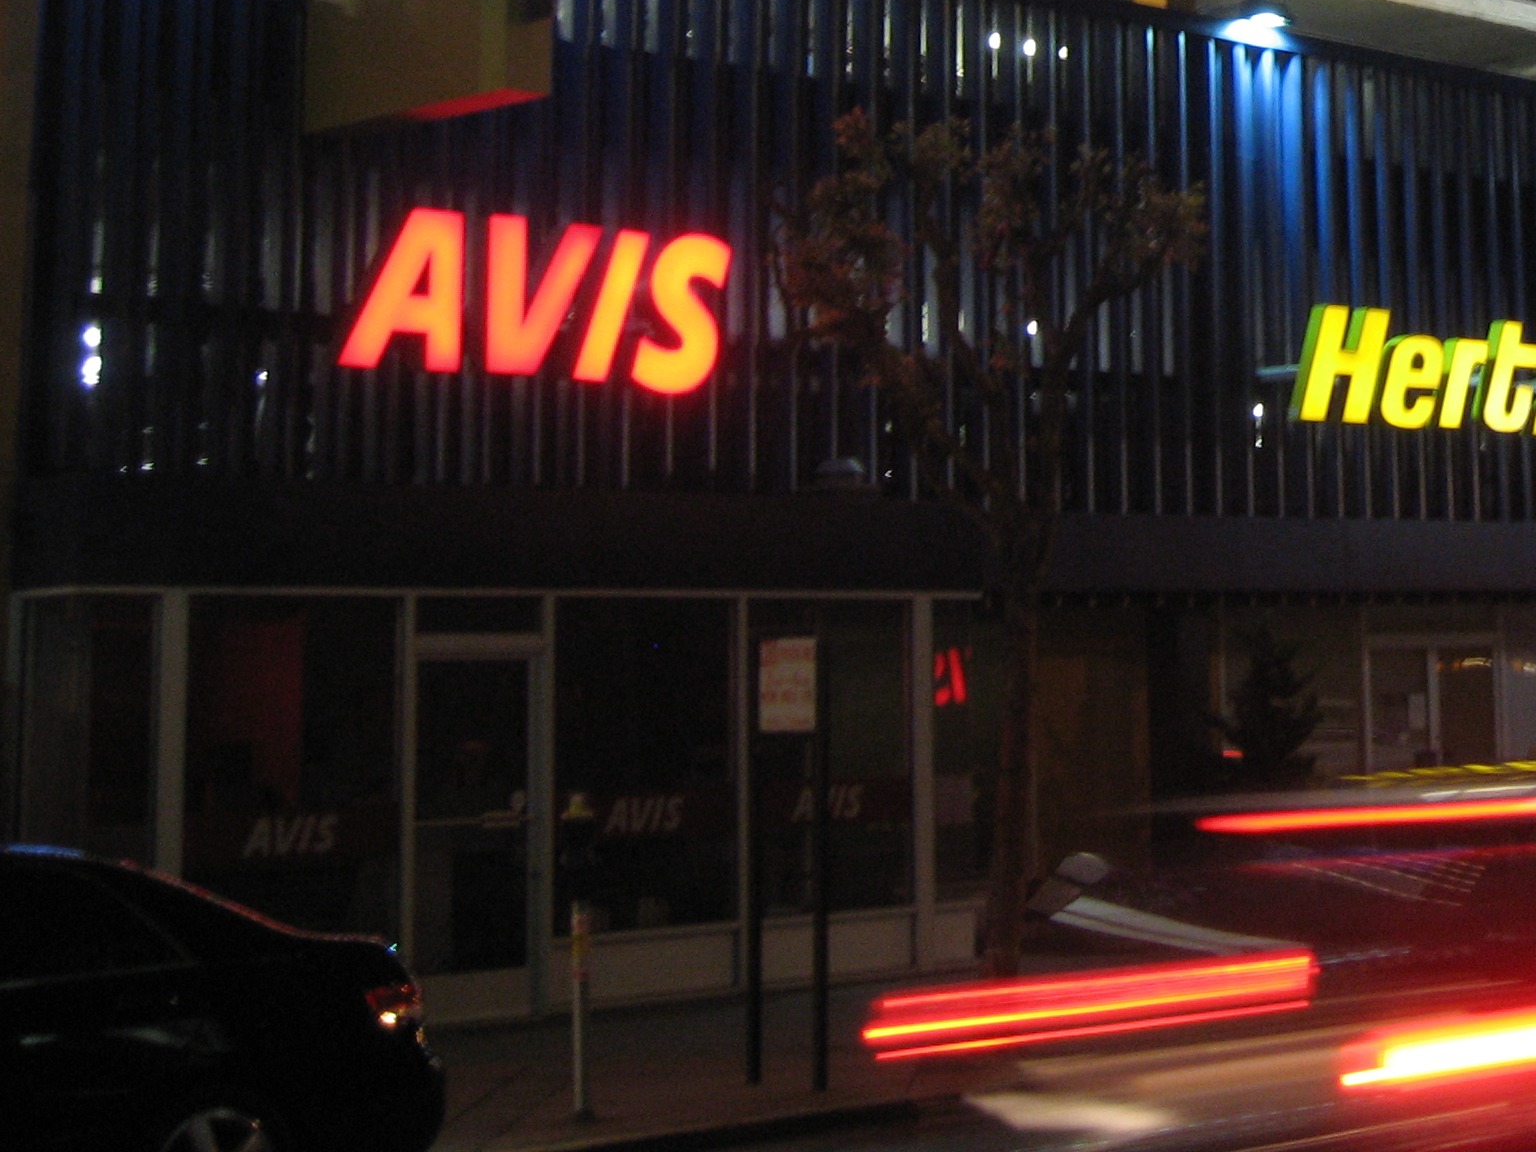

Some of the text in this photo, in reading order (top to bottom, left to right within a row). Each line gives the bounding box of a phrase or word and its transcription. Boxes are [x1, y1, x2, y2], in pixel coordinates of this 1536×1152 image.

[337, 206, 733, 395] AVIS
[244, 814, 339, 858] AVIS
[604, 794, 685, 836] AVIS
